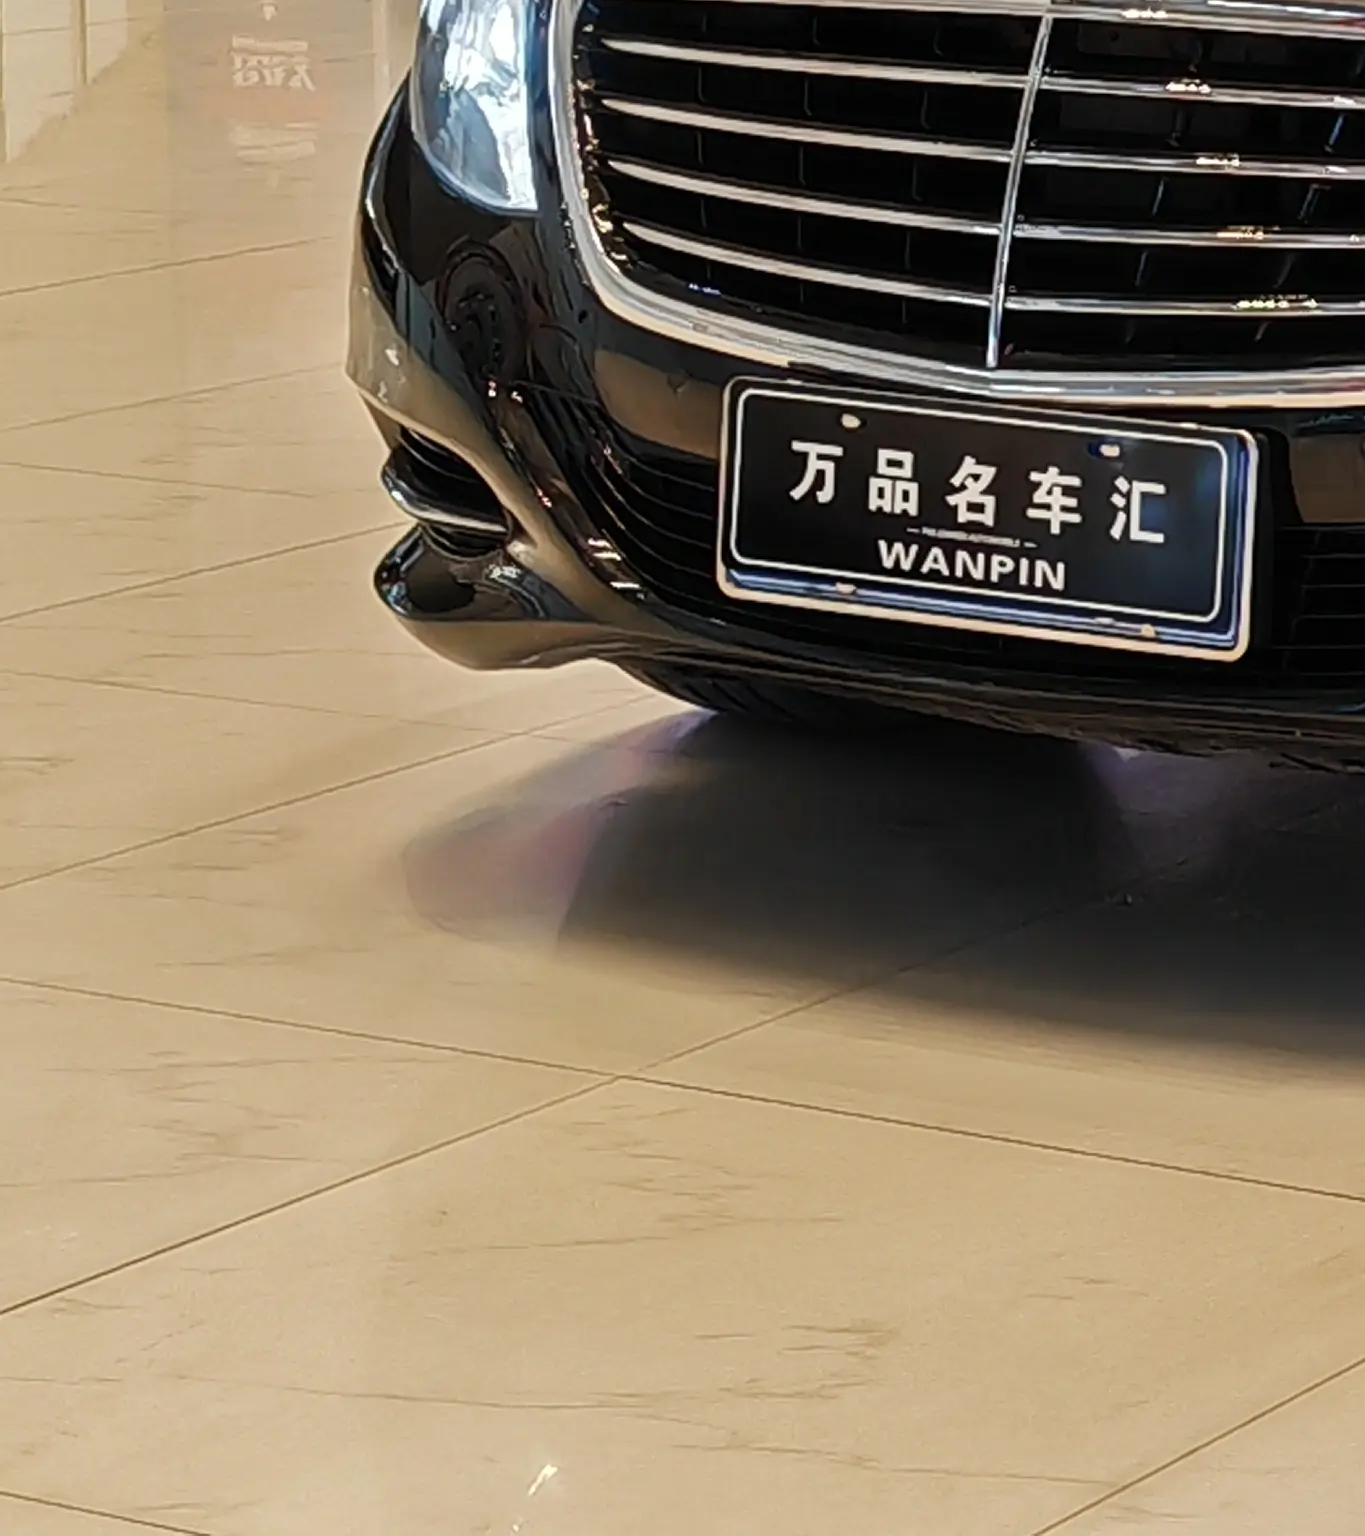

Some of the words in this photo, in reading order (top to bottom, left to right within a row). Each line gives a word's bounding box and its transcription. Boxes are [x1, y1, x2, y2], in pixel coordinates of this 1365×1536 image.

[789, 440, 1167, 544] 万品名车汇
[877, 539, 1067, 591] WANPIN
